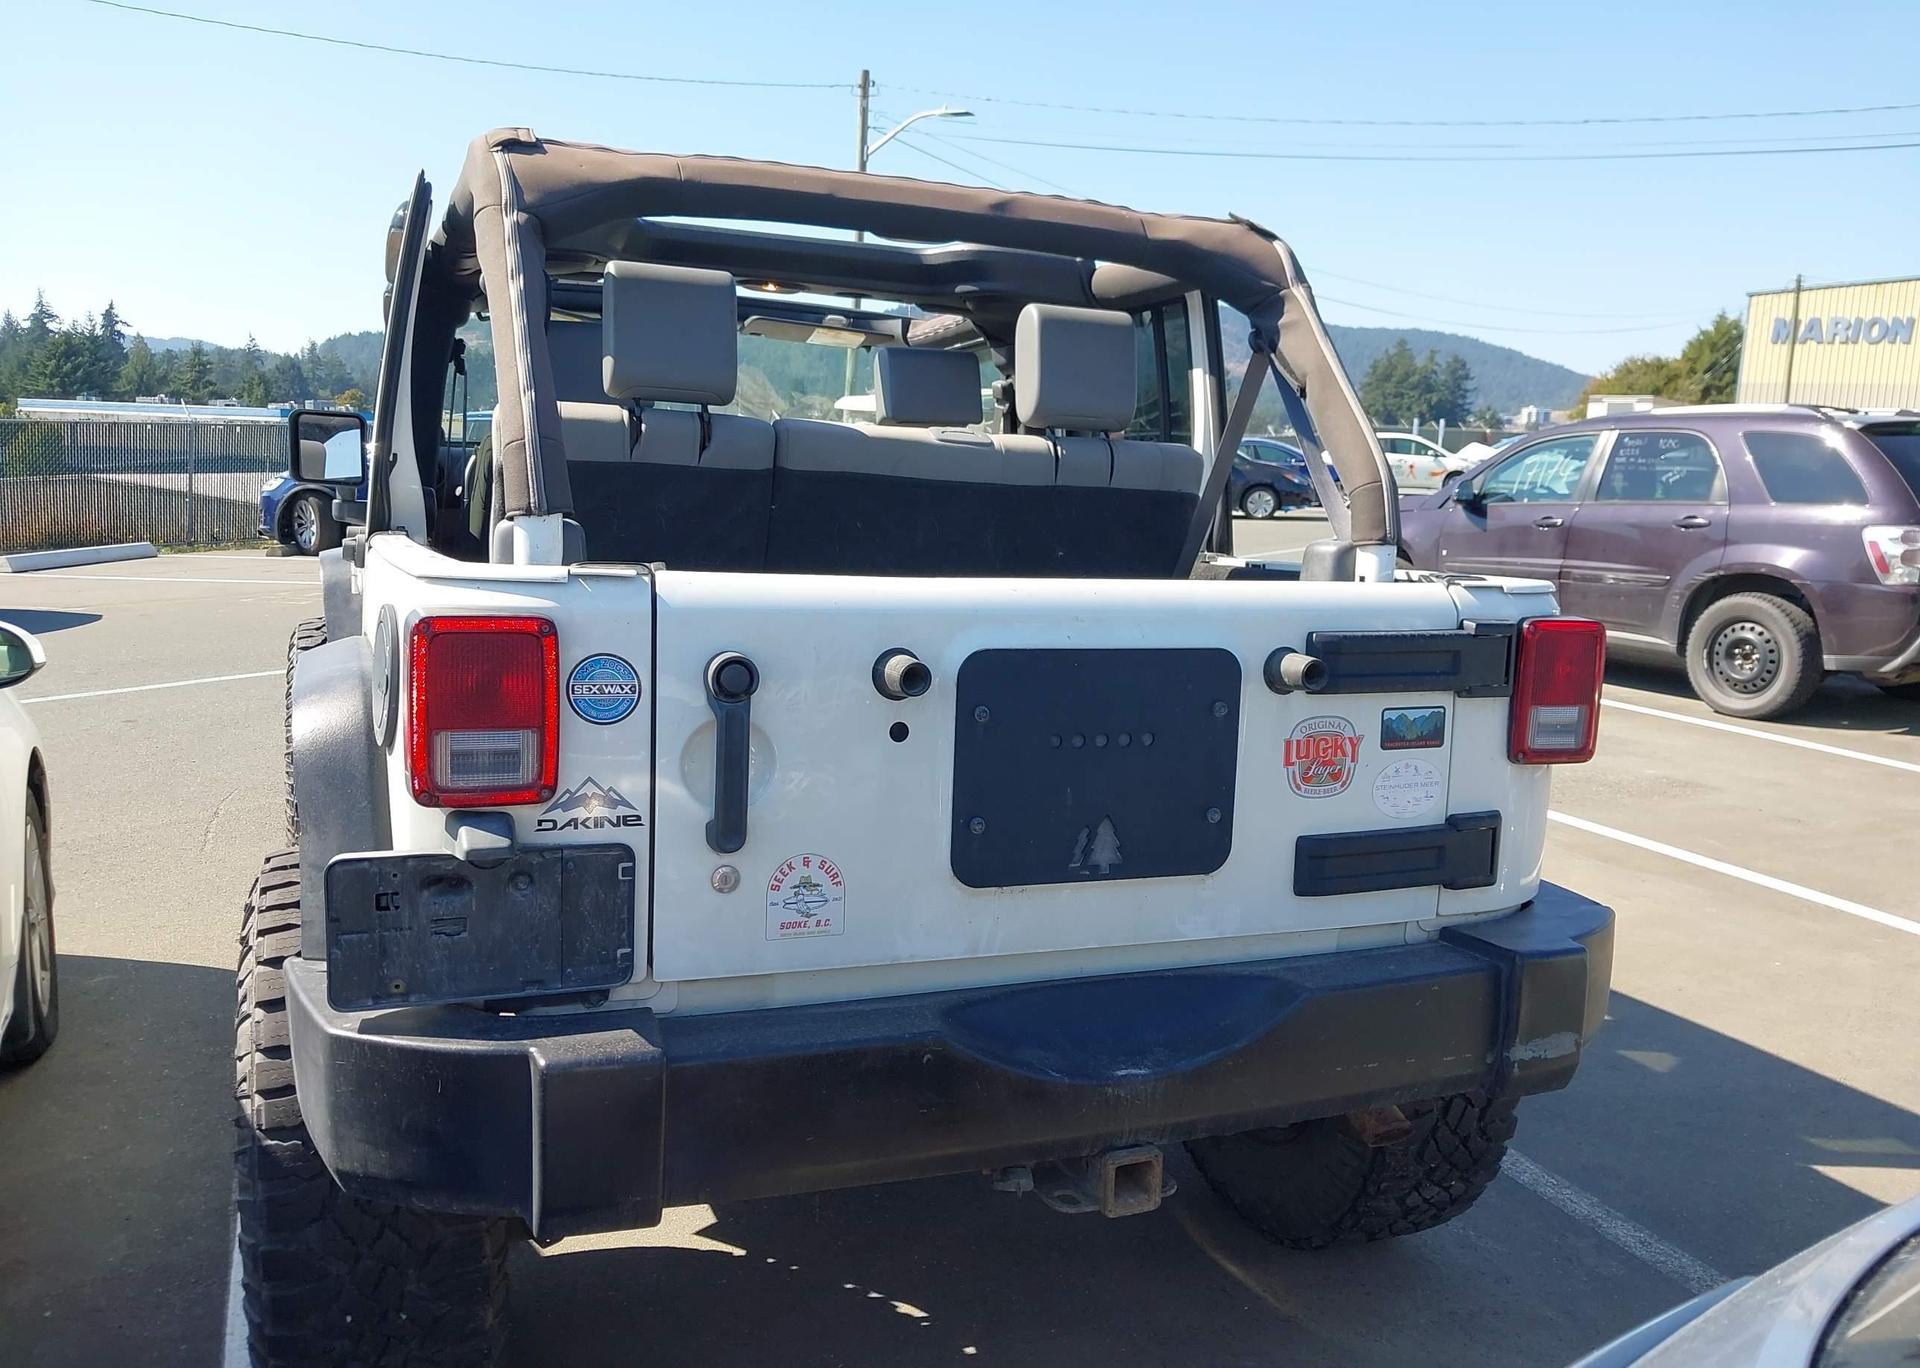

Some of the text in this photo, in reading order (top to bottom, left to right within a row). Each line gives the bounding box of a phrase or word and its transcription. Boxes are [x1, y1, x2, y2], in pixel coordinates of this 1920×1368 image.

[1771, 316, 1916, 345] MARION
[574, 684, 632, 694] SEX WAX
[1300, 720, 1348, 734] ORIGINAL
[1283, 734, 1365, 768] LUCKY
[1301, 759, 1343, 784] Lager
[534, 814, 645, 832] DAKINE
[770, 856, 843, 892] SEEK & SURF
[779, 920, 811, 930] SOOKE,
